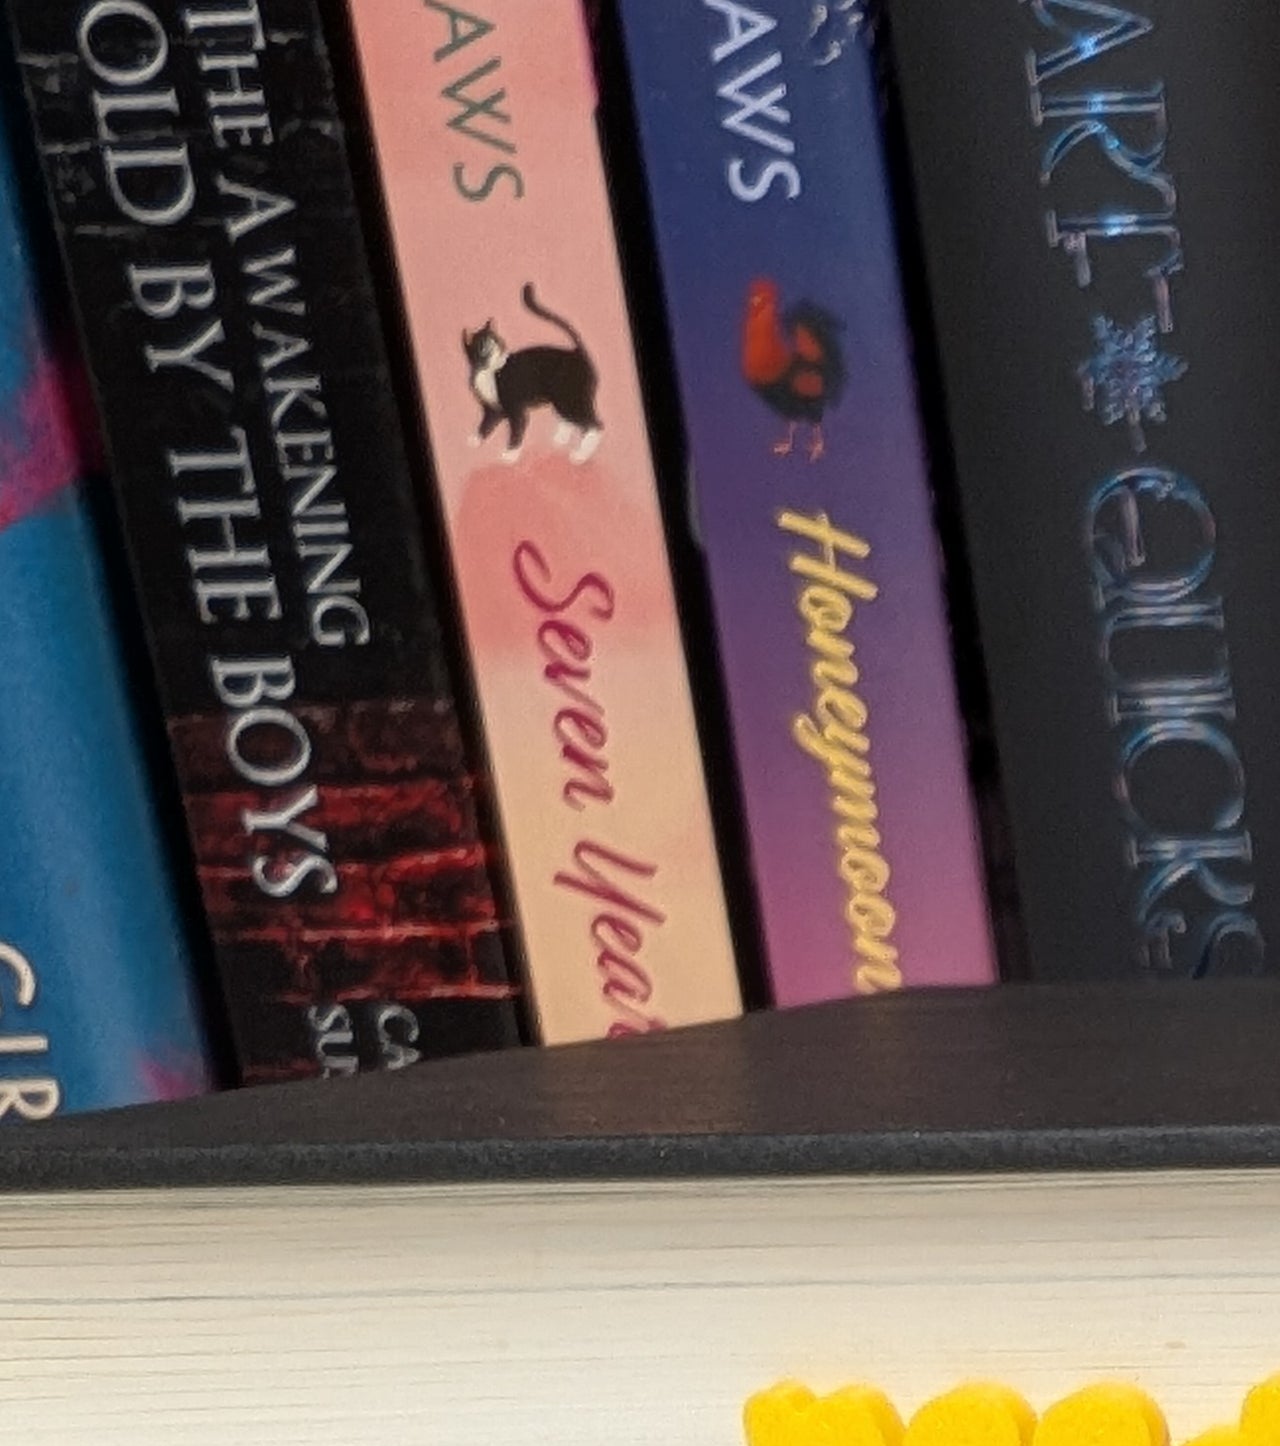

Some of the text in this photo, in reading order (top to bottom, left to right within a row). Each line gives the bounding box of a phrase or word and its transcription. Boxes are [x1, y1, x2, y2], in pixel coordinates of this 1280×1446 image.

[423, 0, 526, 202] AWS
[708, 0, 802, 203] AWS
[77, 0, 339, 900] OLD BY THE BOYS
[180, 0, 369, 650] THE AWAKENING
[512, 539, 616, 812] Seven
[778, 511, 903, 996] Honeymoon
